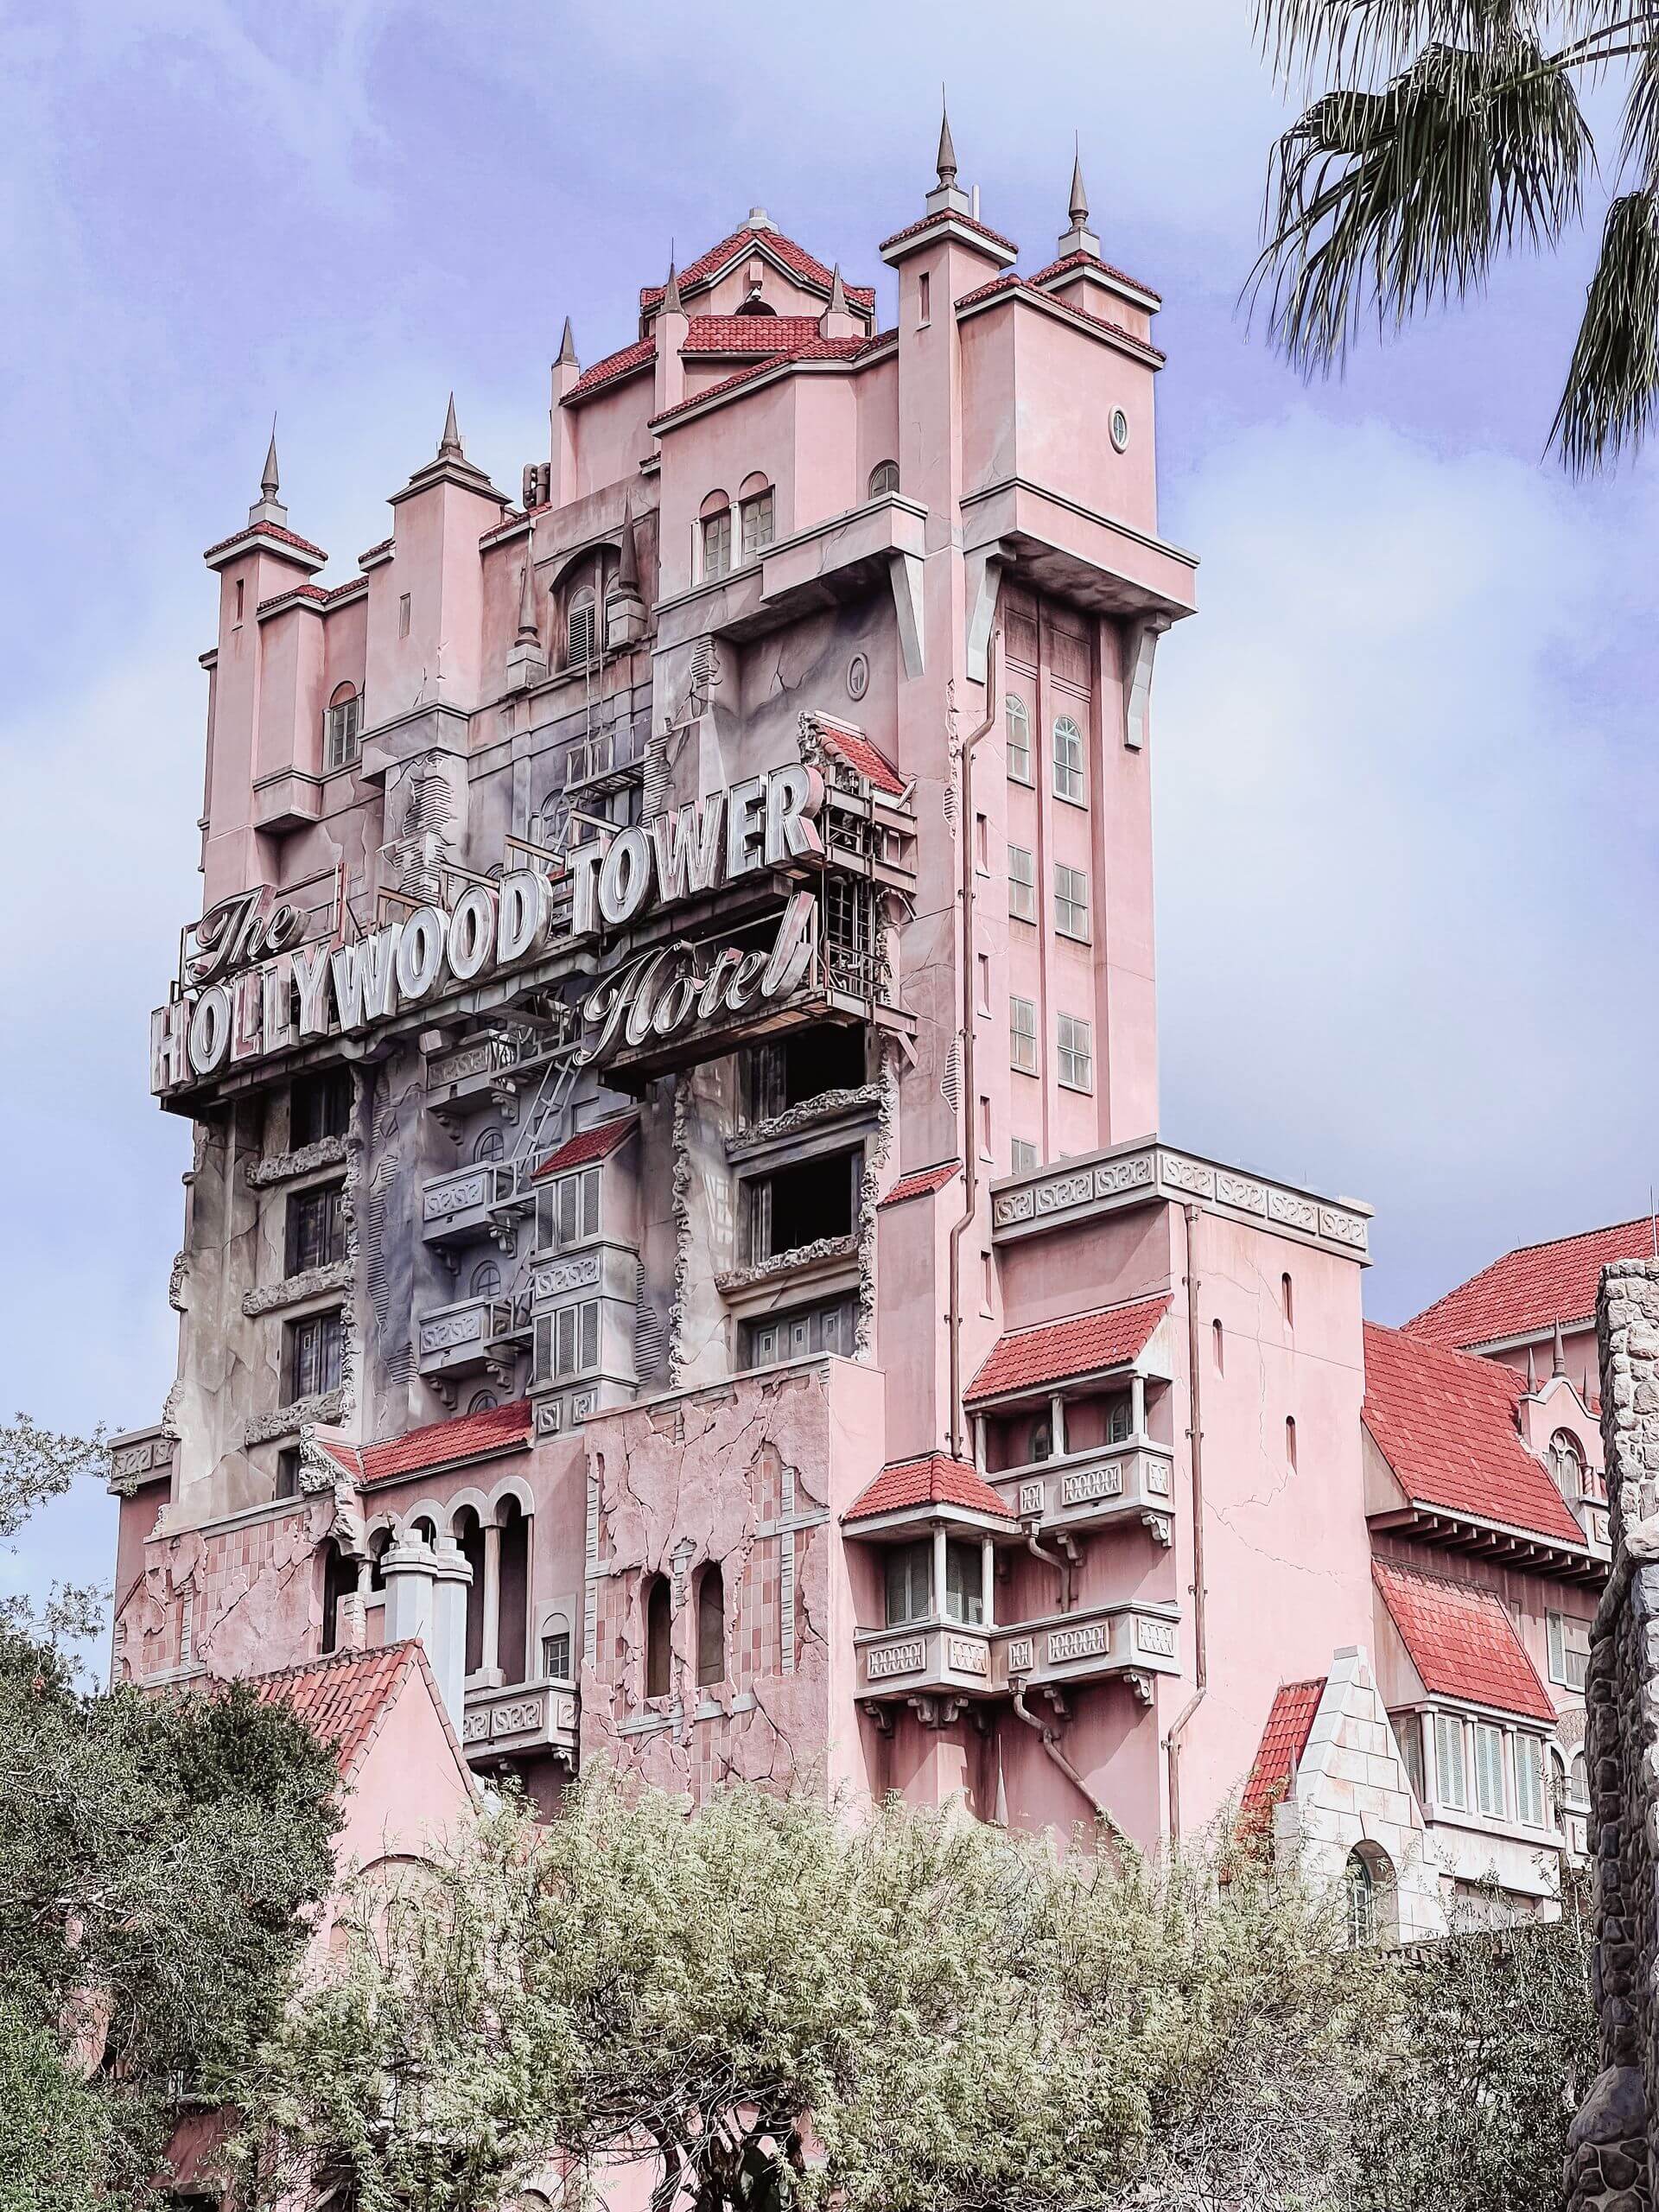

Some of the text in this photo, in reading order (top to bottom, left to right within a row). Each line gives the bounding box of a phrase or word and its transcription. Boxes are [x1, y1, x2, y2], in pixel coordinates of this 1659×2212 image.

[150, 763, 825, 1096] HOLLYWOOD TOWER
[185, 885, 311, 986] The
[573, 890, 815, 1066] Hotel
